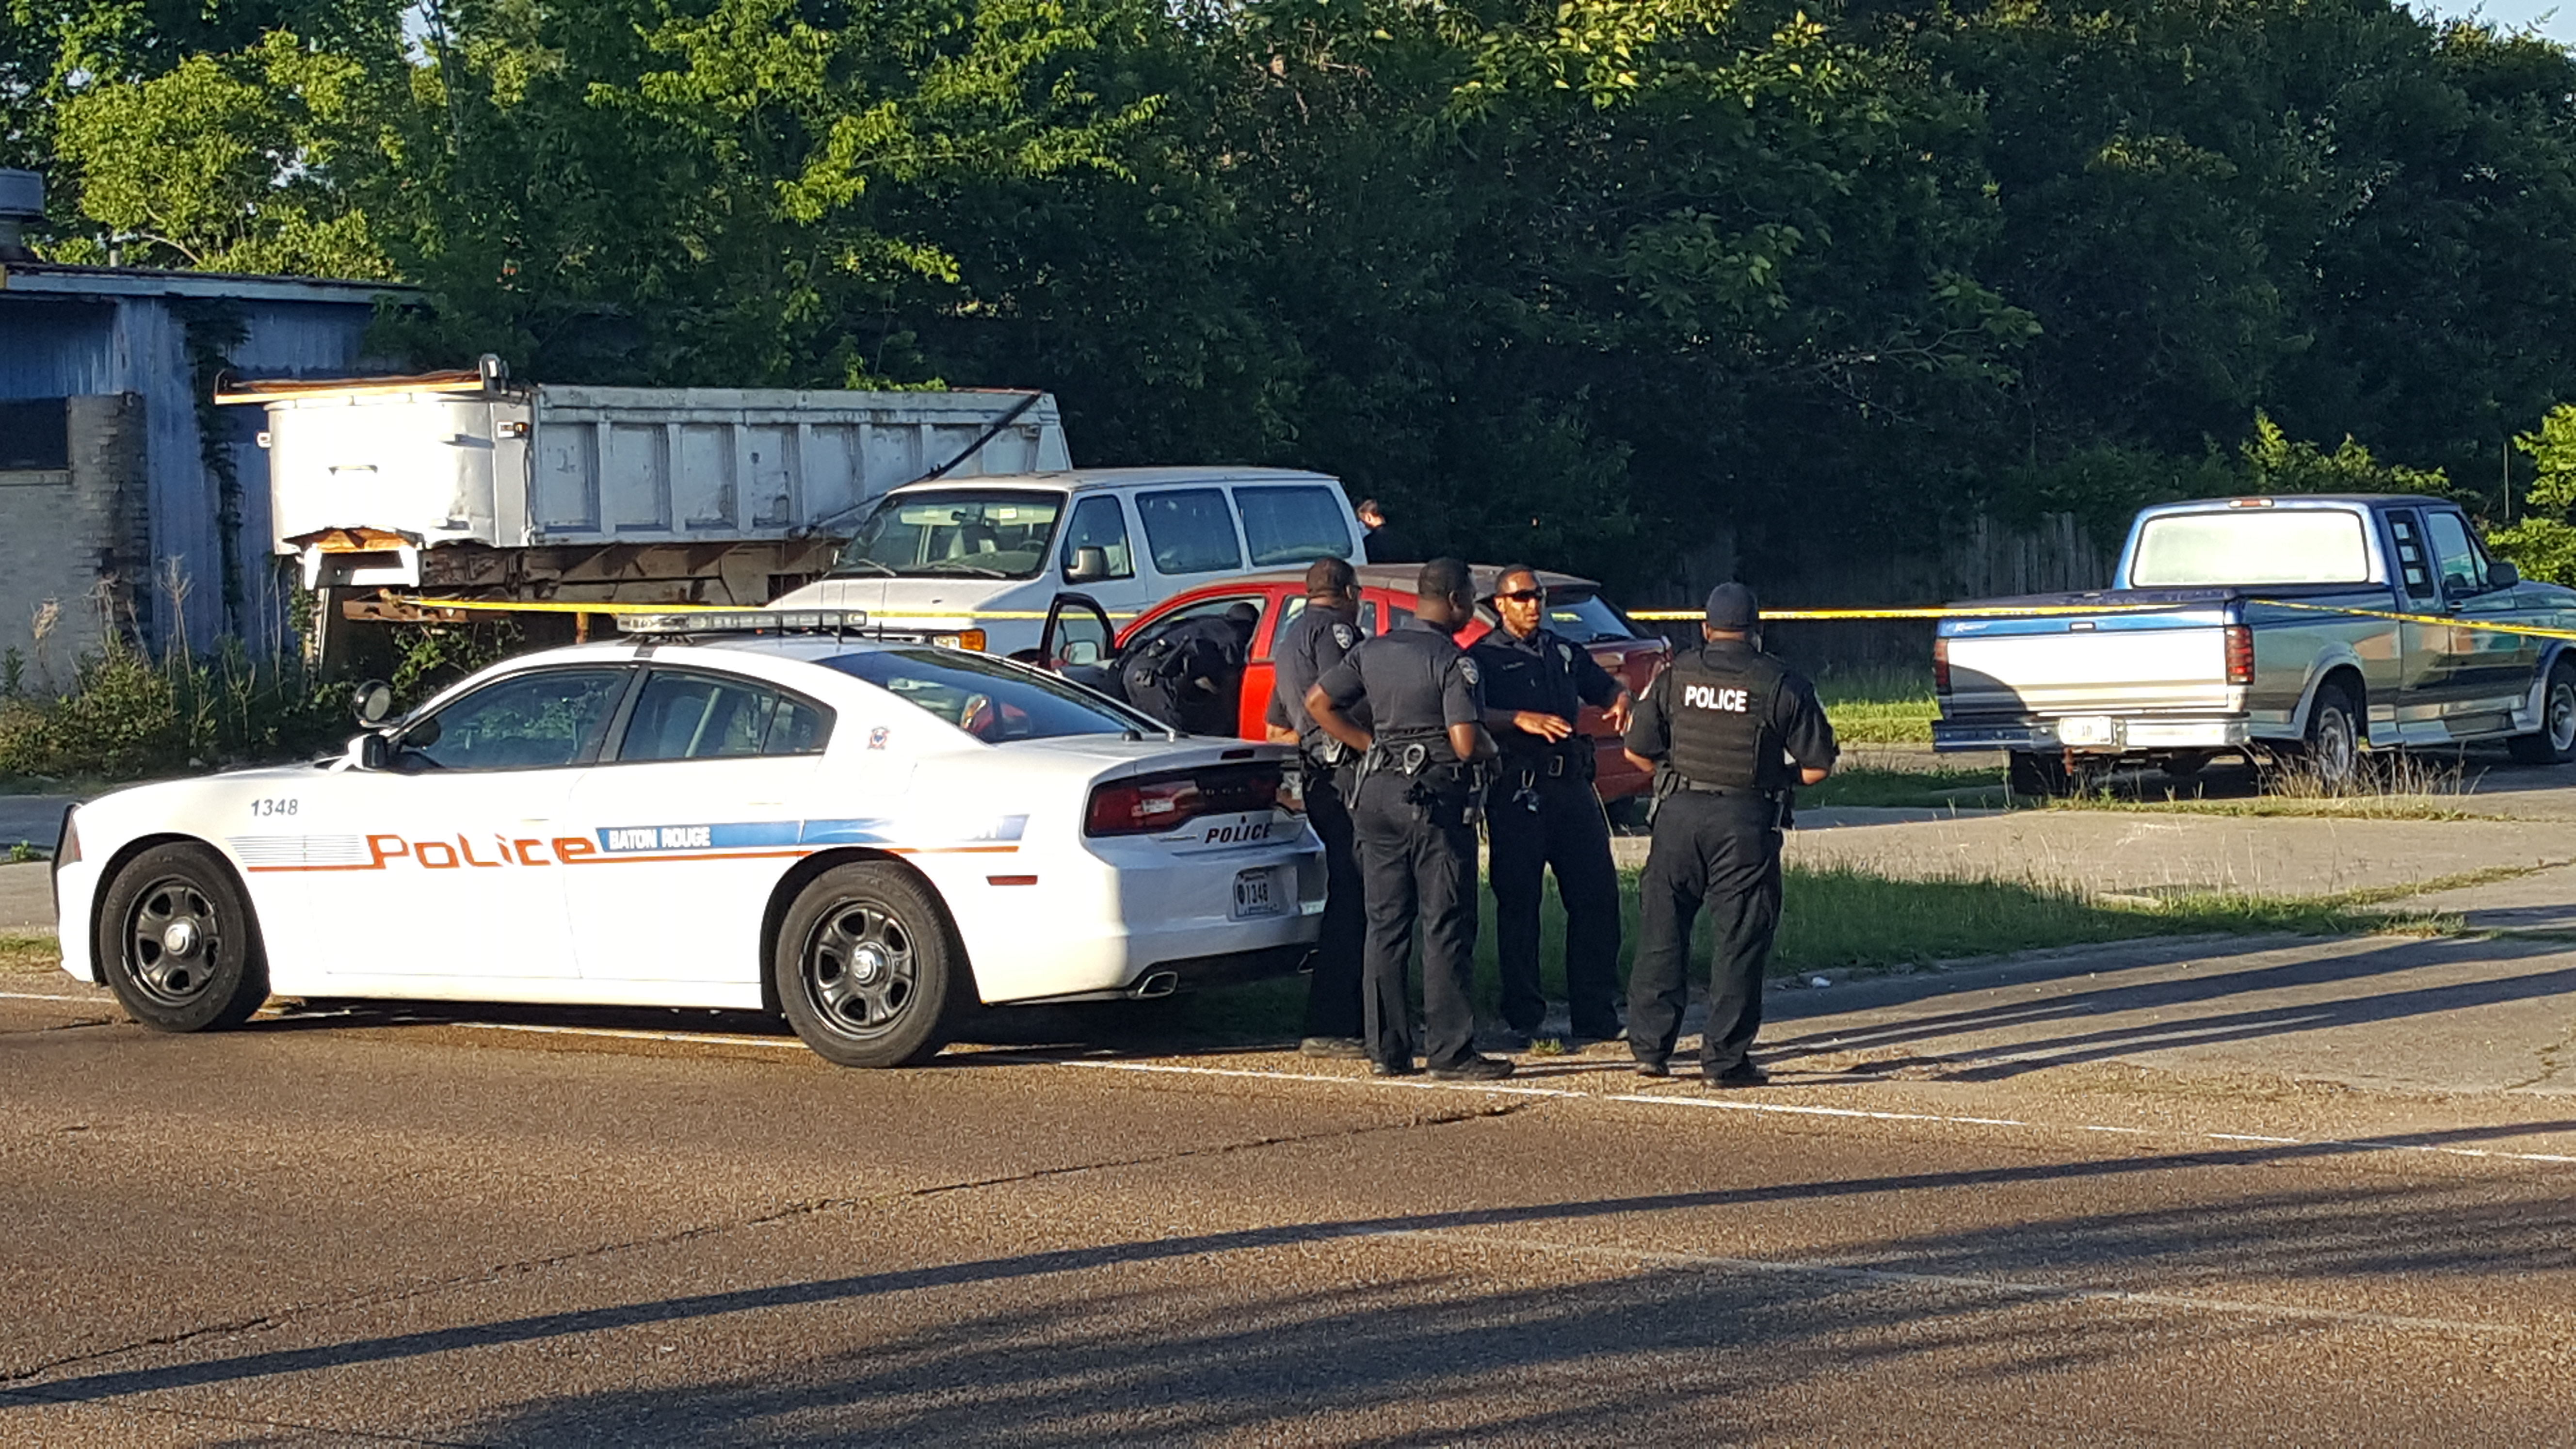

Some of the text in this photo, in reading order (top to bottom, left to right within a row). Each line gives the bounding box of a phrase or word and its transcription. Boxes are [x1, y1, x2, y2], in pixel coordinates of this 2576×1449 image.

[1685, 685, 1748, 712] POLICE
[251, 798, 298, 817] 1348
[609, 826, 711, 850] BATON ROUGE
[1204, 823, 1272, 844] POLICE
[1246, 882, 1268, 904] 1348
